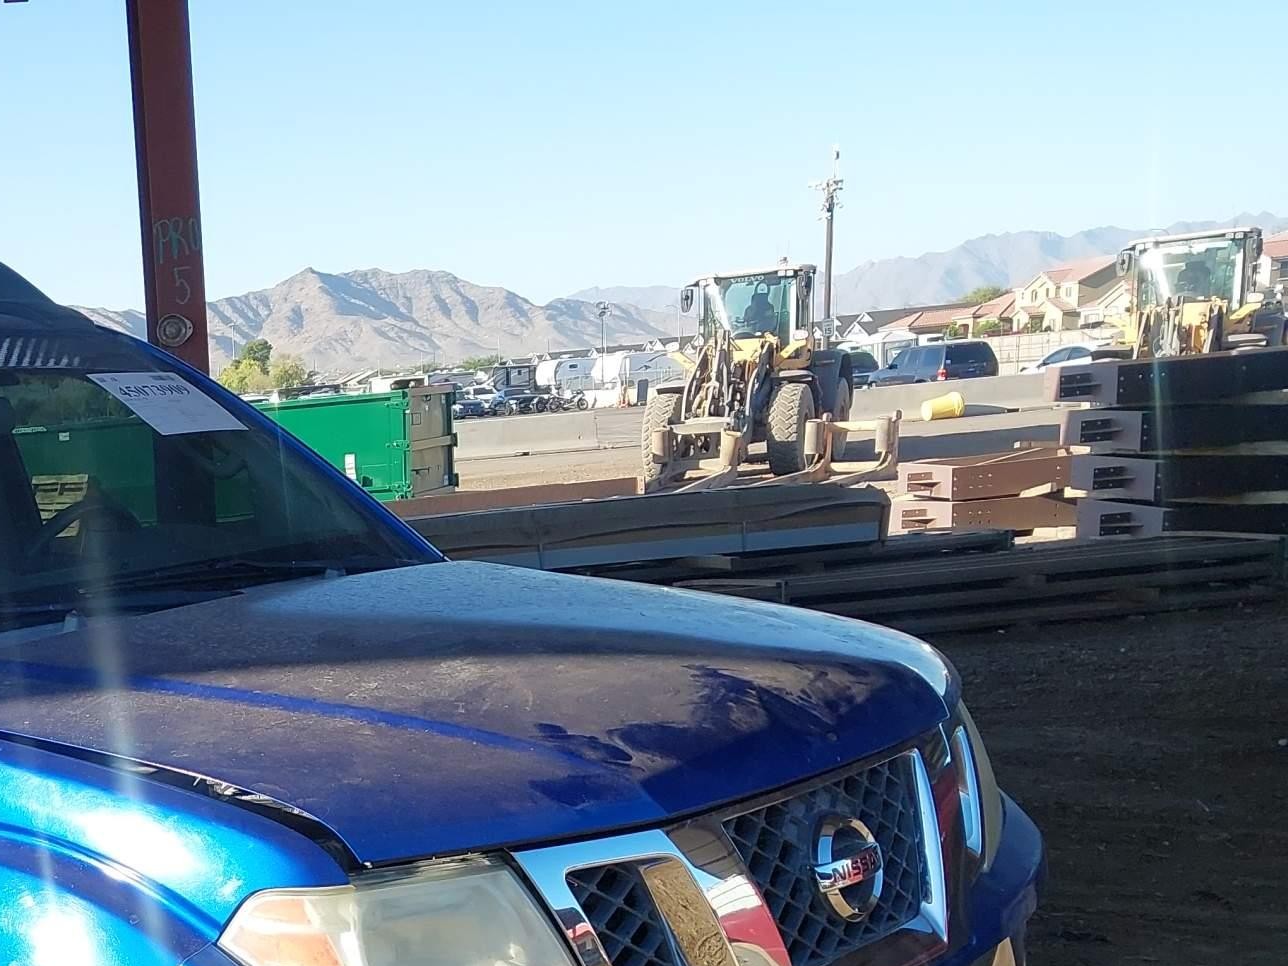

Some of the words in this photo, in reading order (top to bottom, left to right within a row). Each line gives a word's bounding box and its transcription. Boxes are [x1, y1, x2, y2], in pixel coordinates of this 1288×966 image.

[173, 265, 191, 305] 5
[730, 274, 765, 284] VOLVO
[824, 327, 832, 335] 15
[118, 382, 190, 399] 45073909
